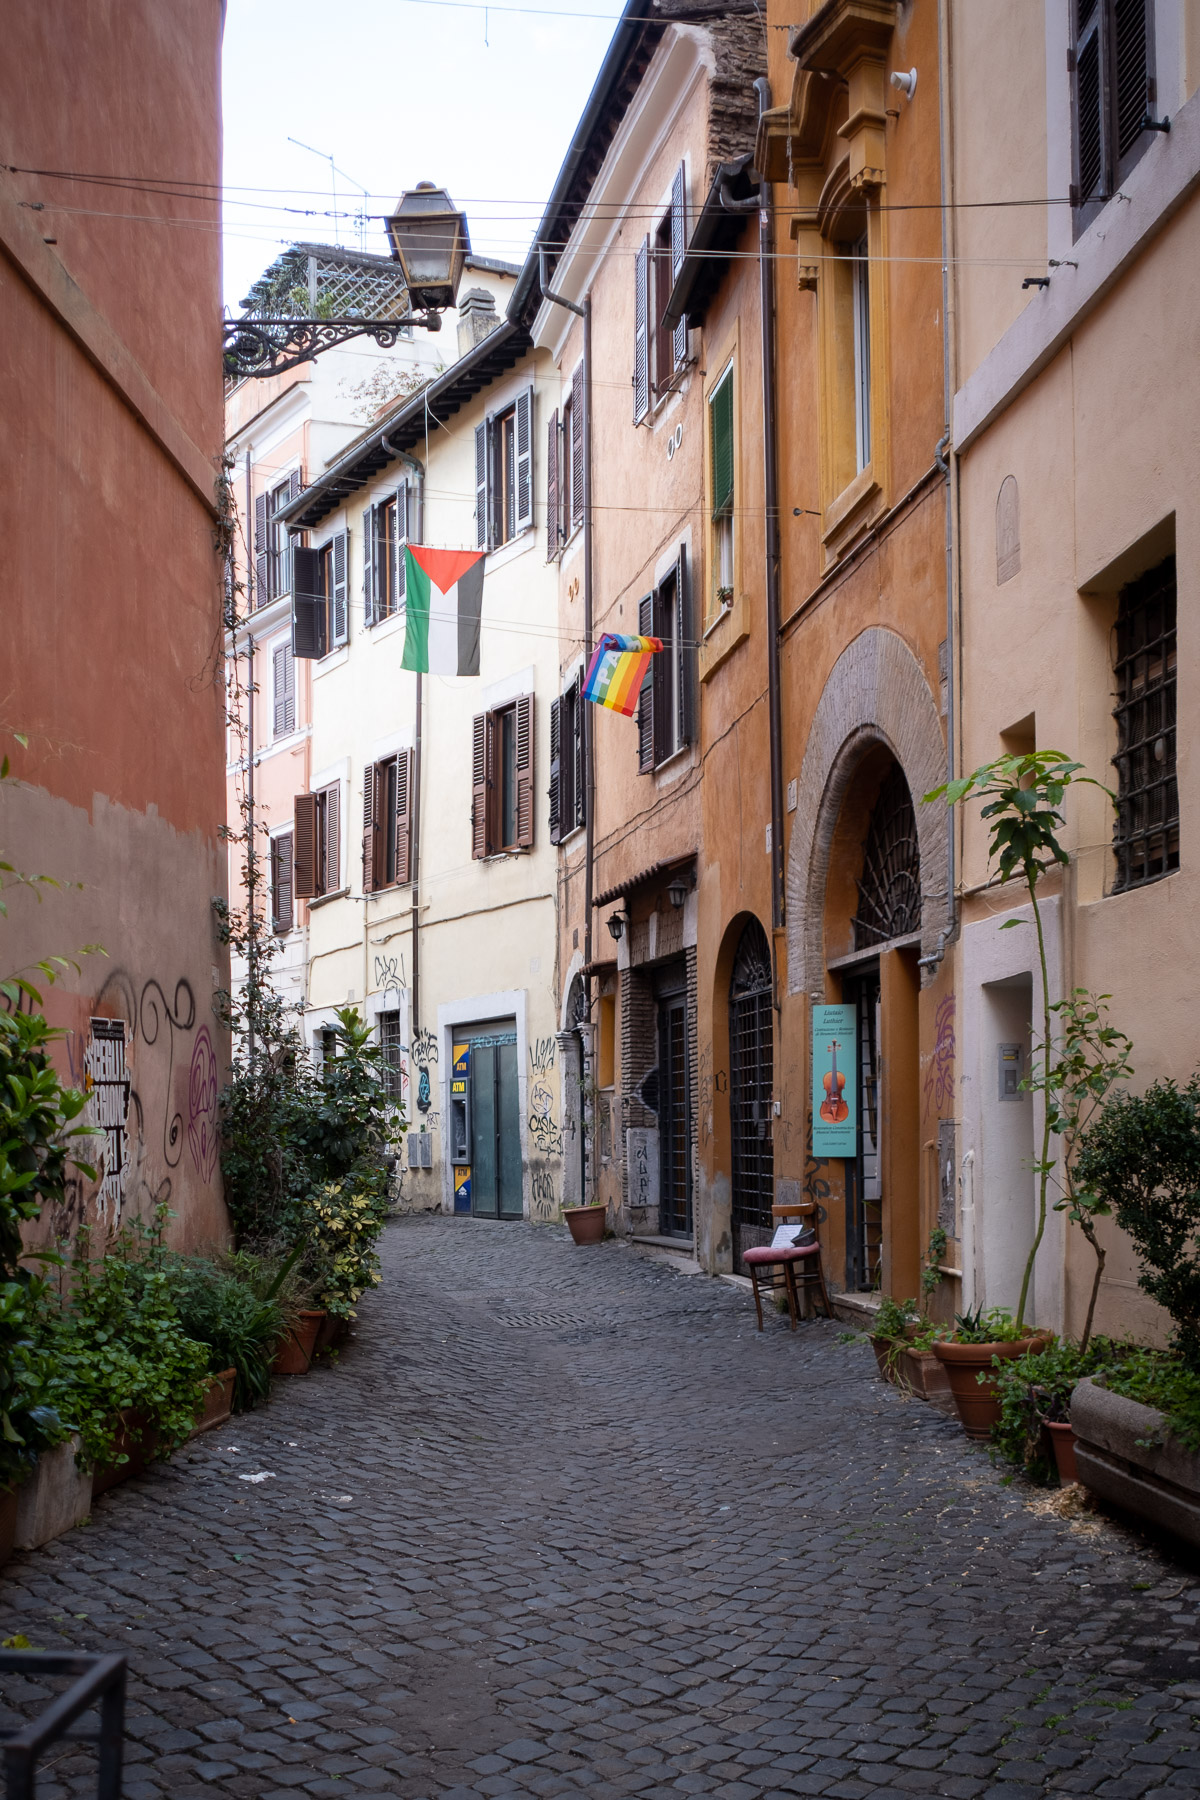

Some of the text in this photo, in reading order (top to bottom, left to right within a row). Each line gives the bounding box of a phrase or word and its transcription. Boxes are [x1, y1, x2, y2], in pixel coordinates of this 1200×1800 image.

[456, 1062, 467, 1071] ATM
[452, 1081, 465, 1093] ATM
[457, 1168, 468, 1176] ATM
